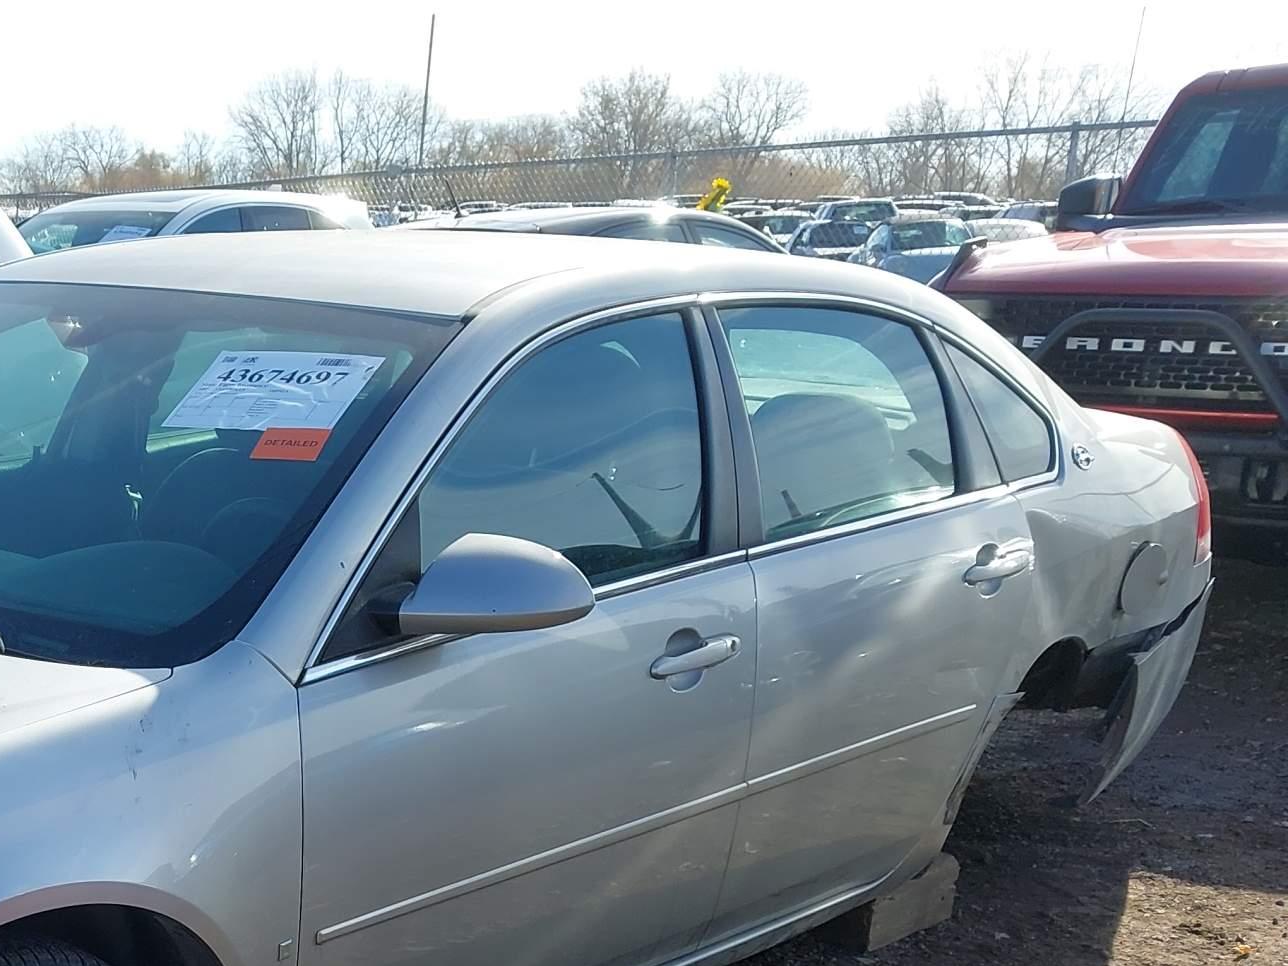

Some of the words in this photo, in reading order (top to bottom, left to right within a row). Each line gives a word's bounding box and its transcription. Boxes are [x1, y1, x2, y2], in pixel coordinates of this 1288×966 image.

[1021, 335, 1288, 356] BRONCO
[216, 368, 350, 386] 43674697
[264, 438, 319, 449] DETAILED
